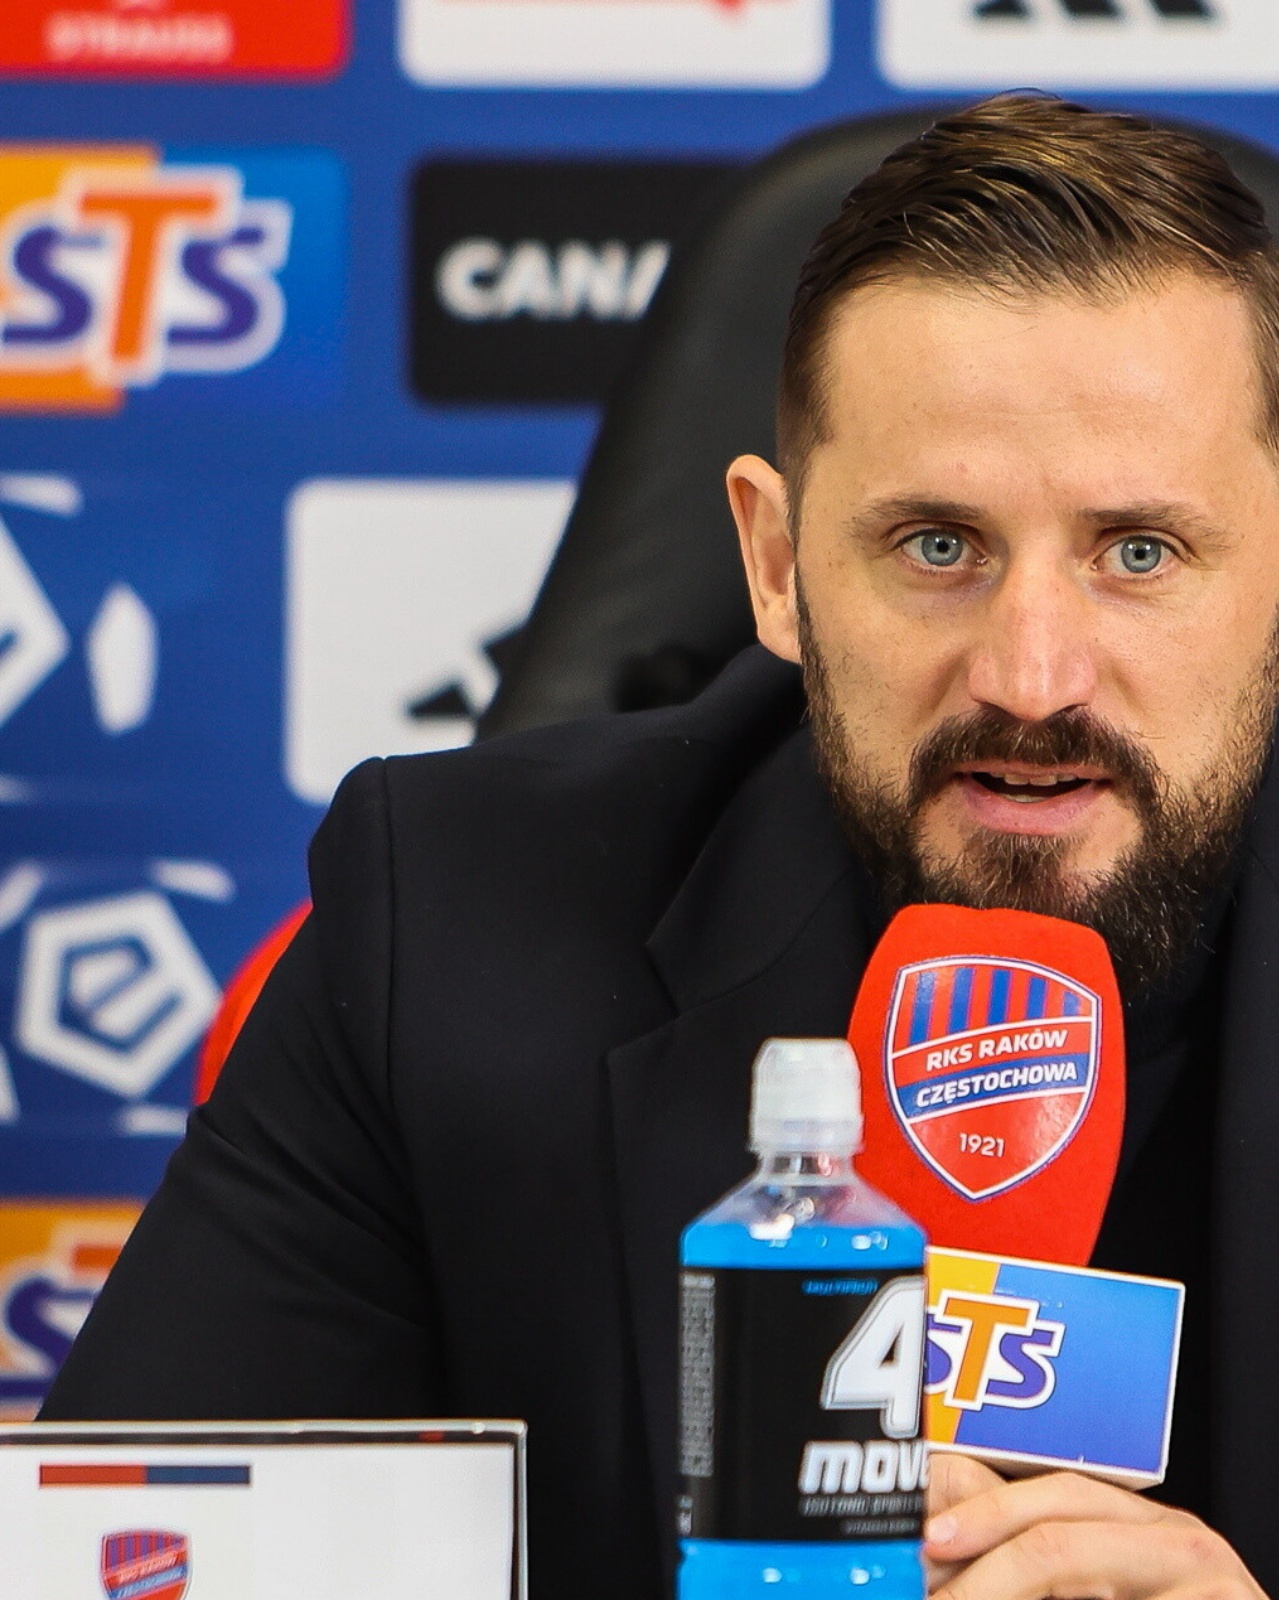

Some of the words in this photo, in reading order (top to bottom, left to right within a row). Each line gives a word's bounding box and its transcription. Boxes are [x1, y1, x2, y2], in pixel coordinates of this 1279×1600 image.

[0, 176, 284, 380] STS
[926, 1042, 973, 1072] RKS
[978, 1028, 1068, 1059] RAKÓW
[916, 1061, 1078, 1108] CZĘSTOCHOWA
[959, 1132, 1005, 1157] 1921
[821, 1275, 926, 1439] 4
